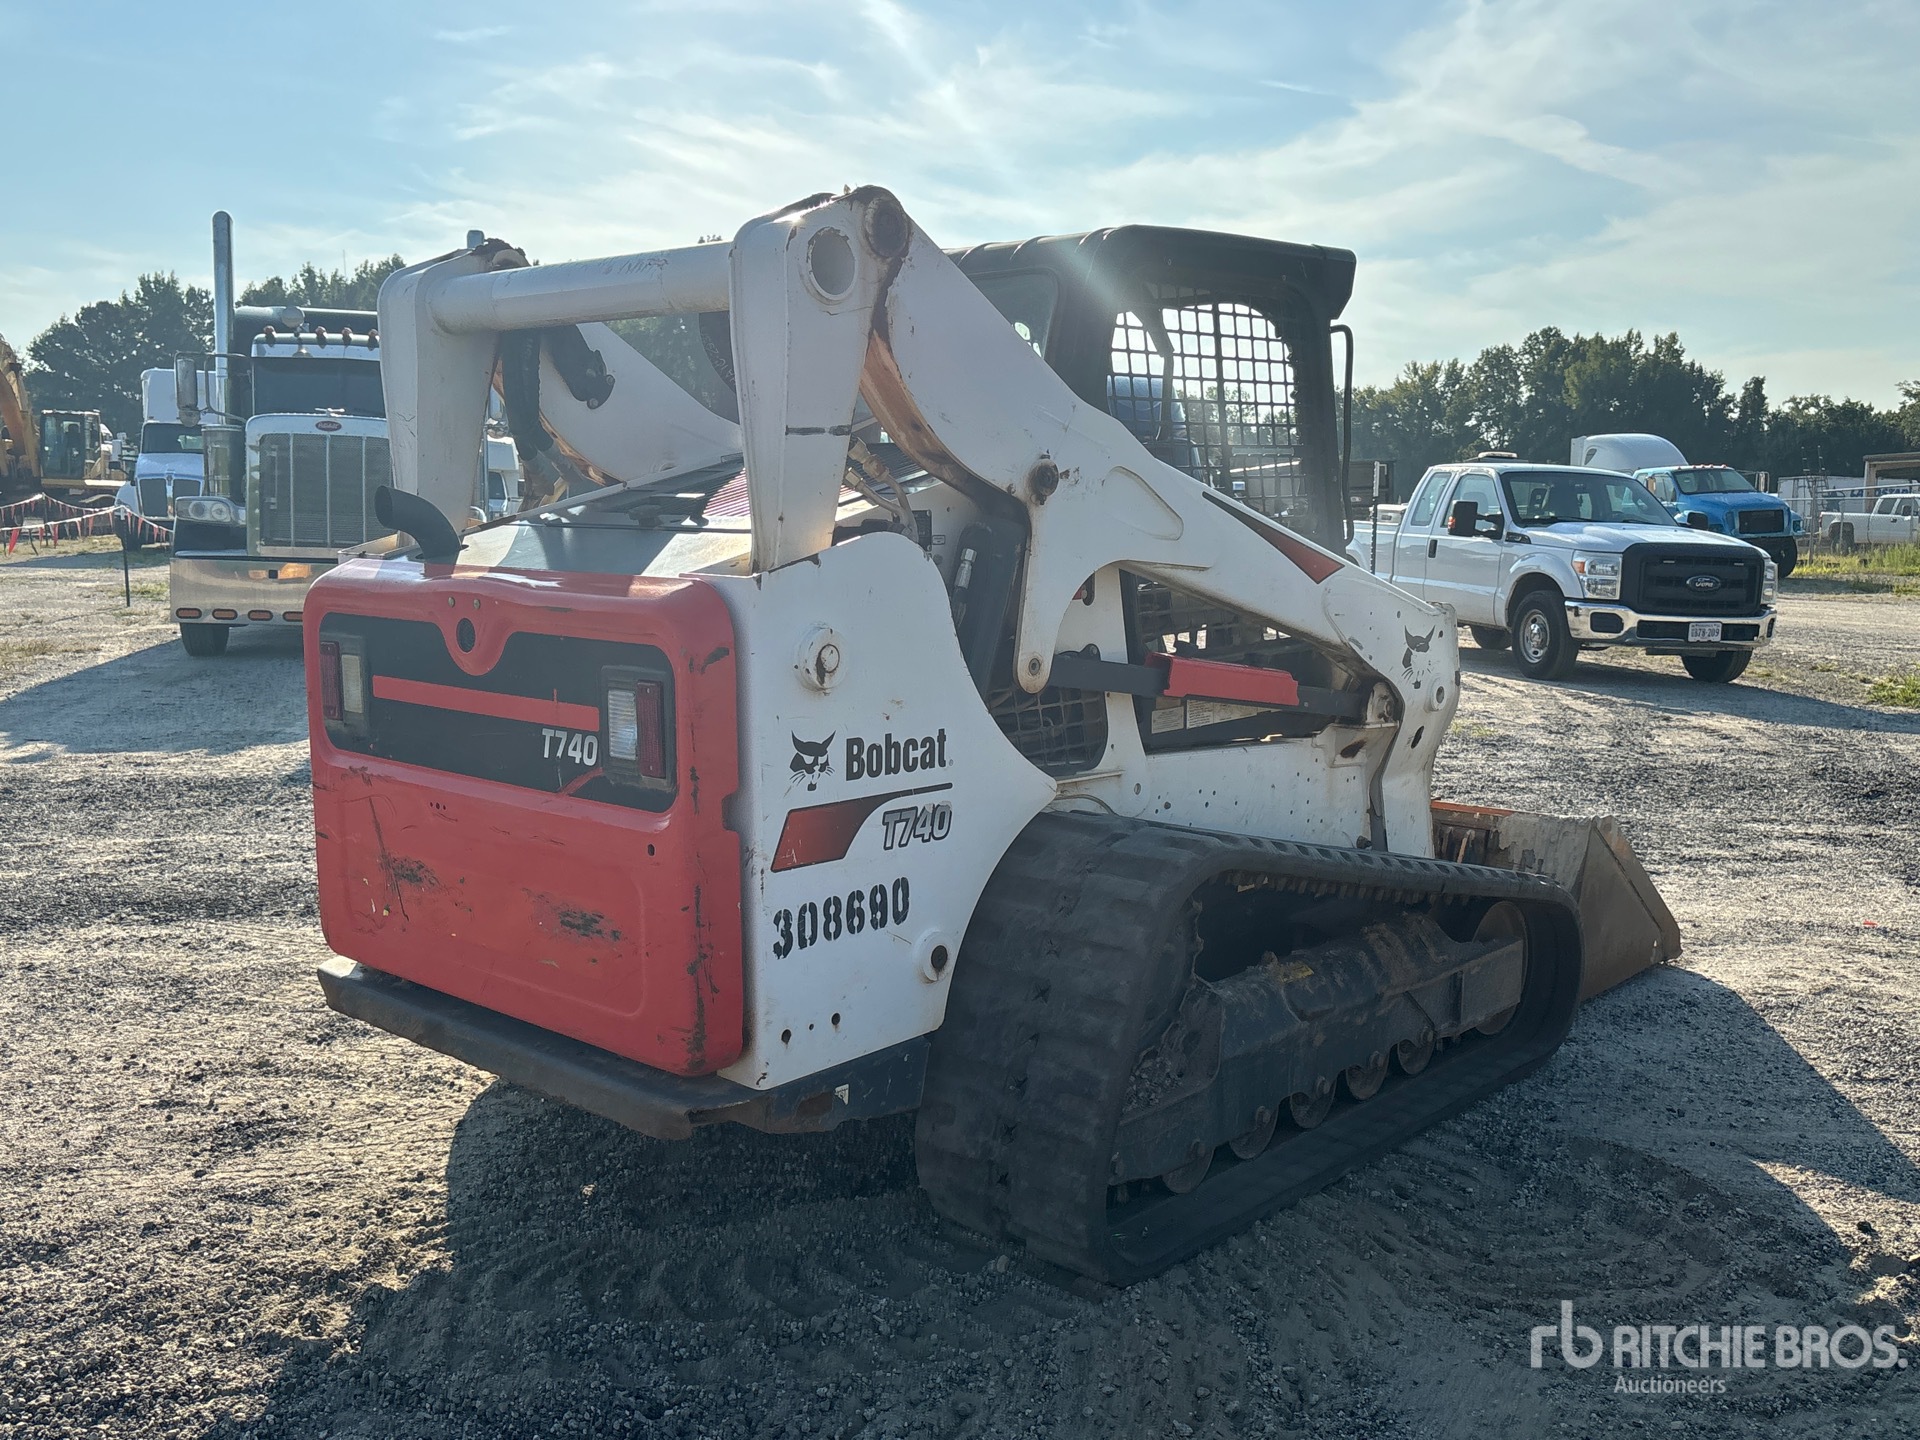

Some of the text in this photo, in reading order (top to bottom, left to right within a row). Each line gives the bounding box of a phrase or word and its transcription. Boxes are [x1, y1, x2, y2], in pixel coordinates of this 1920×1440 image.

[542, 728, 598, 766] T740
[846, 729, 946, 781] Bobcat
[882, 804, 953, 851] T740
[773, 877, 910, 960] 308690
